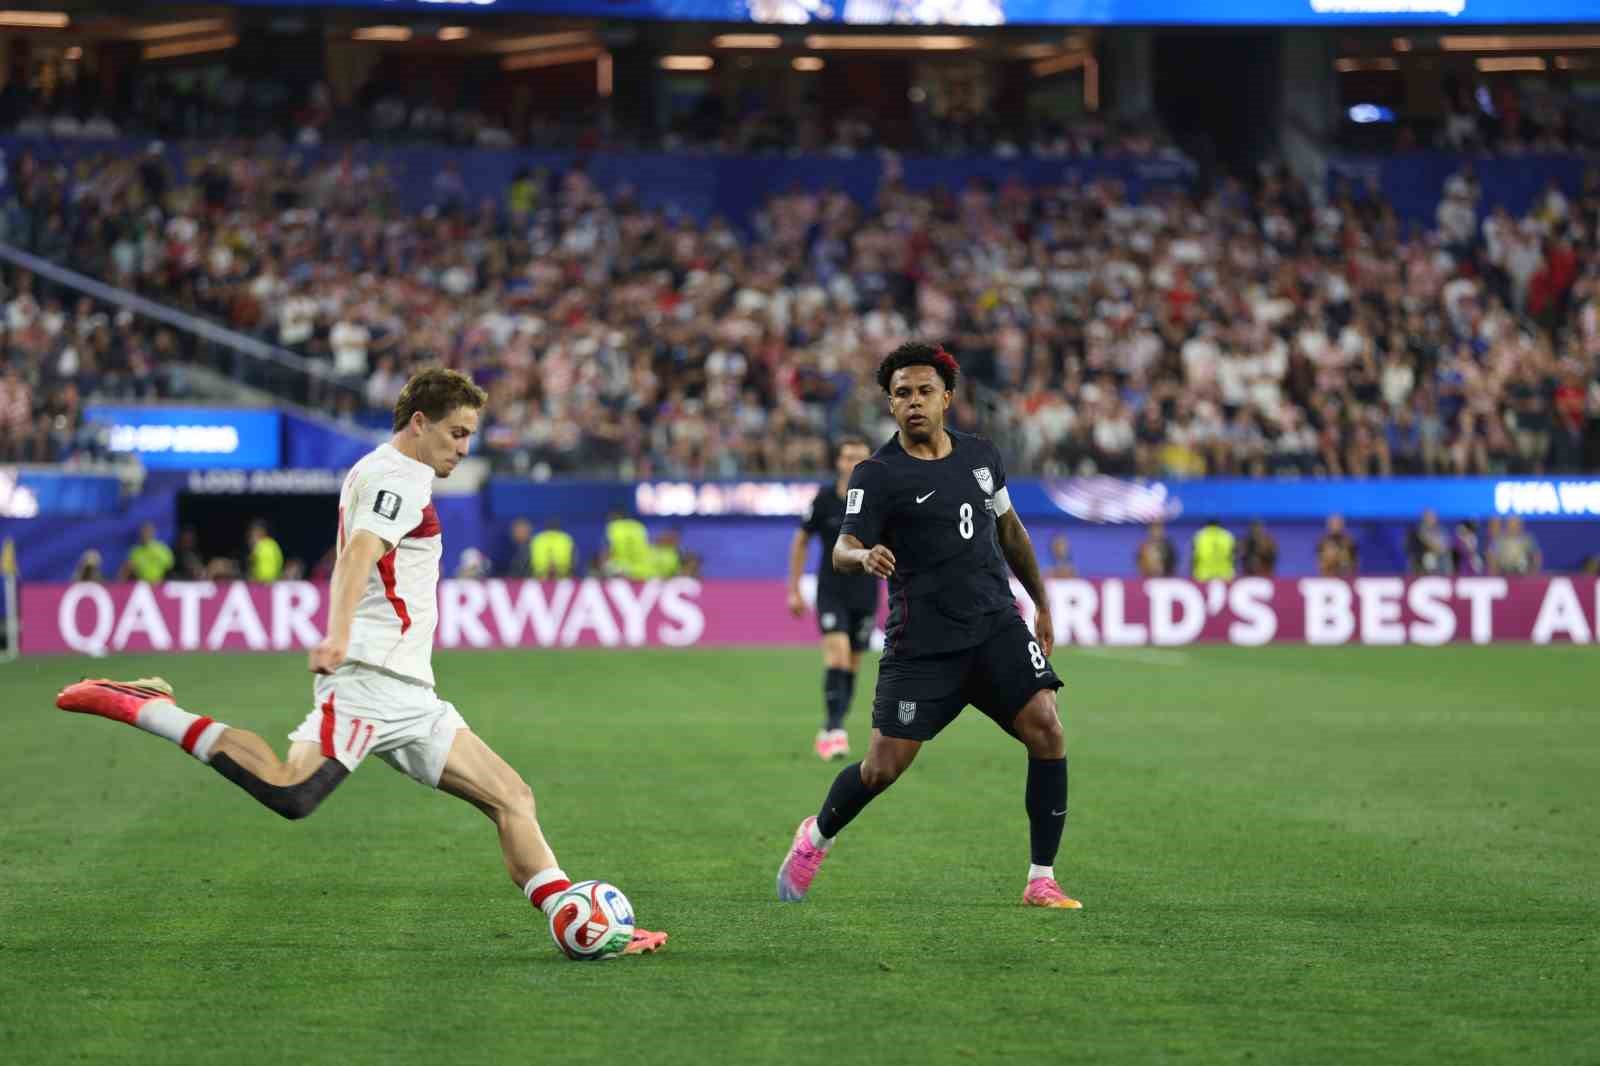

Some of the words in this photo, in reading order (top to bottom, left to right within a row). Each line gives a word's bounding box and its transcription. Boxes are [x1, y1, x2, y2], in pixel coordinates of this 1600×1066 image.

[959, 503, 974, 540] 8
[58, 580, 323, 657] QATAR
[438, 576, 705, 648] RWAYS
[1008, 577, 1278, 646] RLD'S
[1298, 576, 1507, 646] BEST
[1531, 577, 1600, 645] A
[1027, 641, 1046, 670] 8
[899, 703, 917, 712] USA
[346, 718, 375, 760] 11
